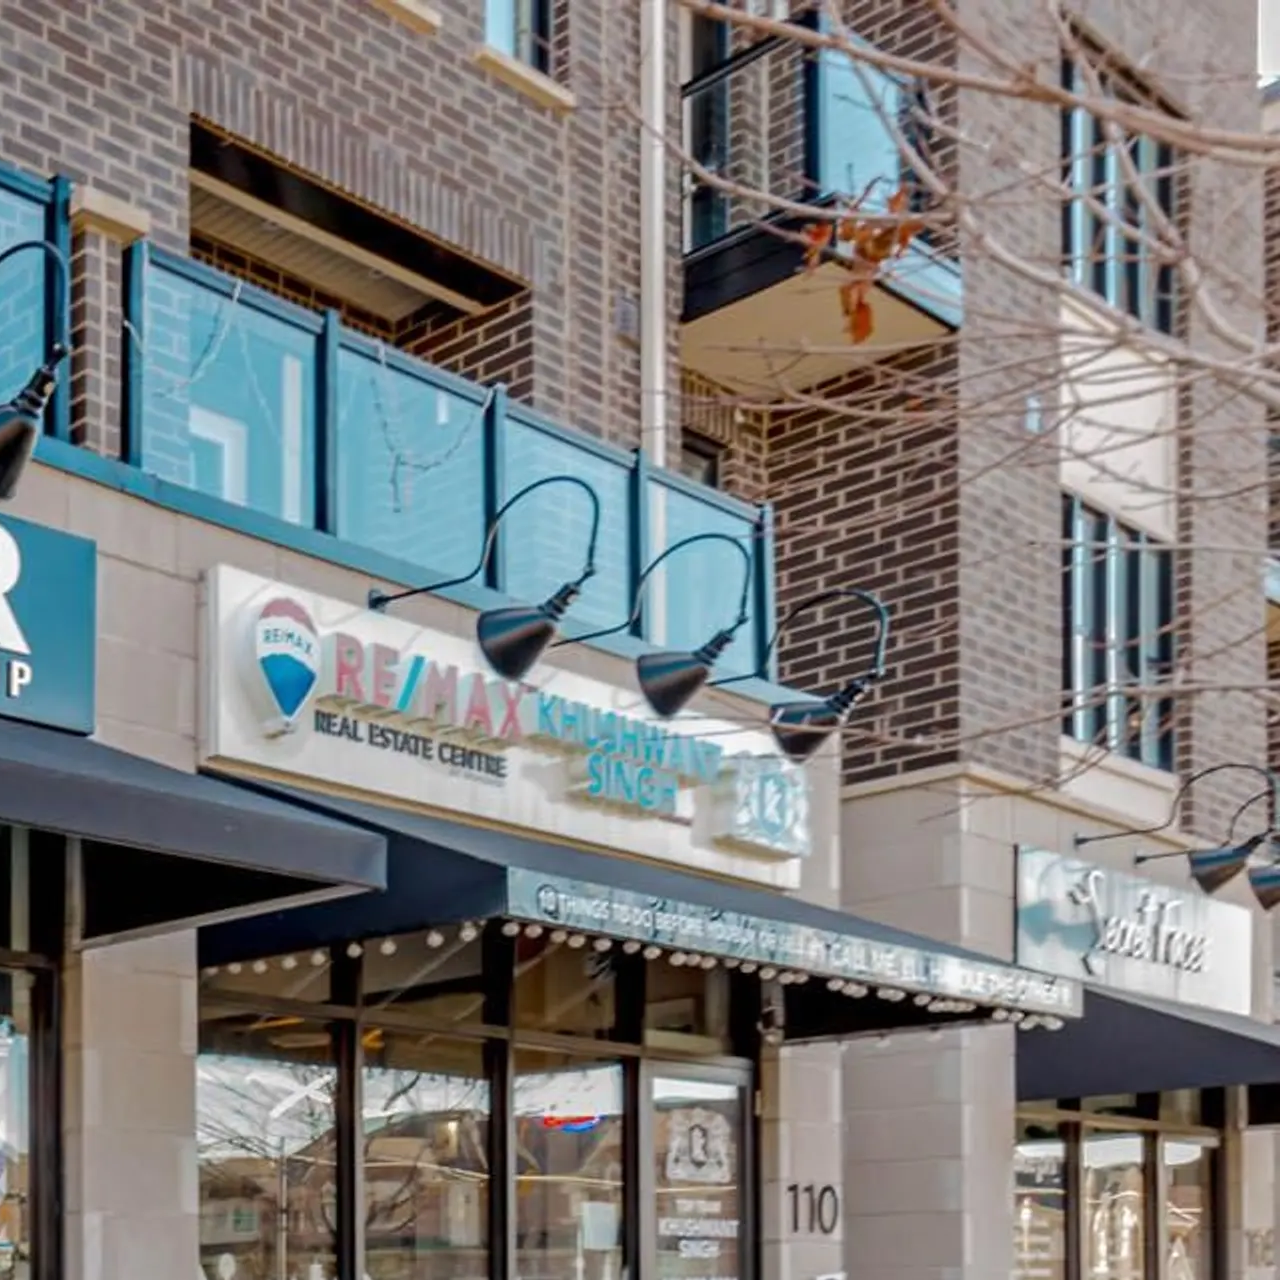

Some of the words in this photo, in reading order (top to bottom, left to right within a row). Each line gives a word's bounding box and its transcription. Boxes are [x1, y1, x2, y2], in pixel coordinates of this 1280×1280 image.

[263, 628, 313, 655] RE/MAX
[335, 632, 530, 741] RE/MAX
[313, 709, 363, 743] REAL
[368, 725, 433, 760] ESTATE
[438, 742, 507, 778] CENTRE
[558, 894, 610, 919] THINGS
[787, 1184, 839, 1236] 110
